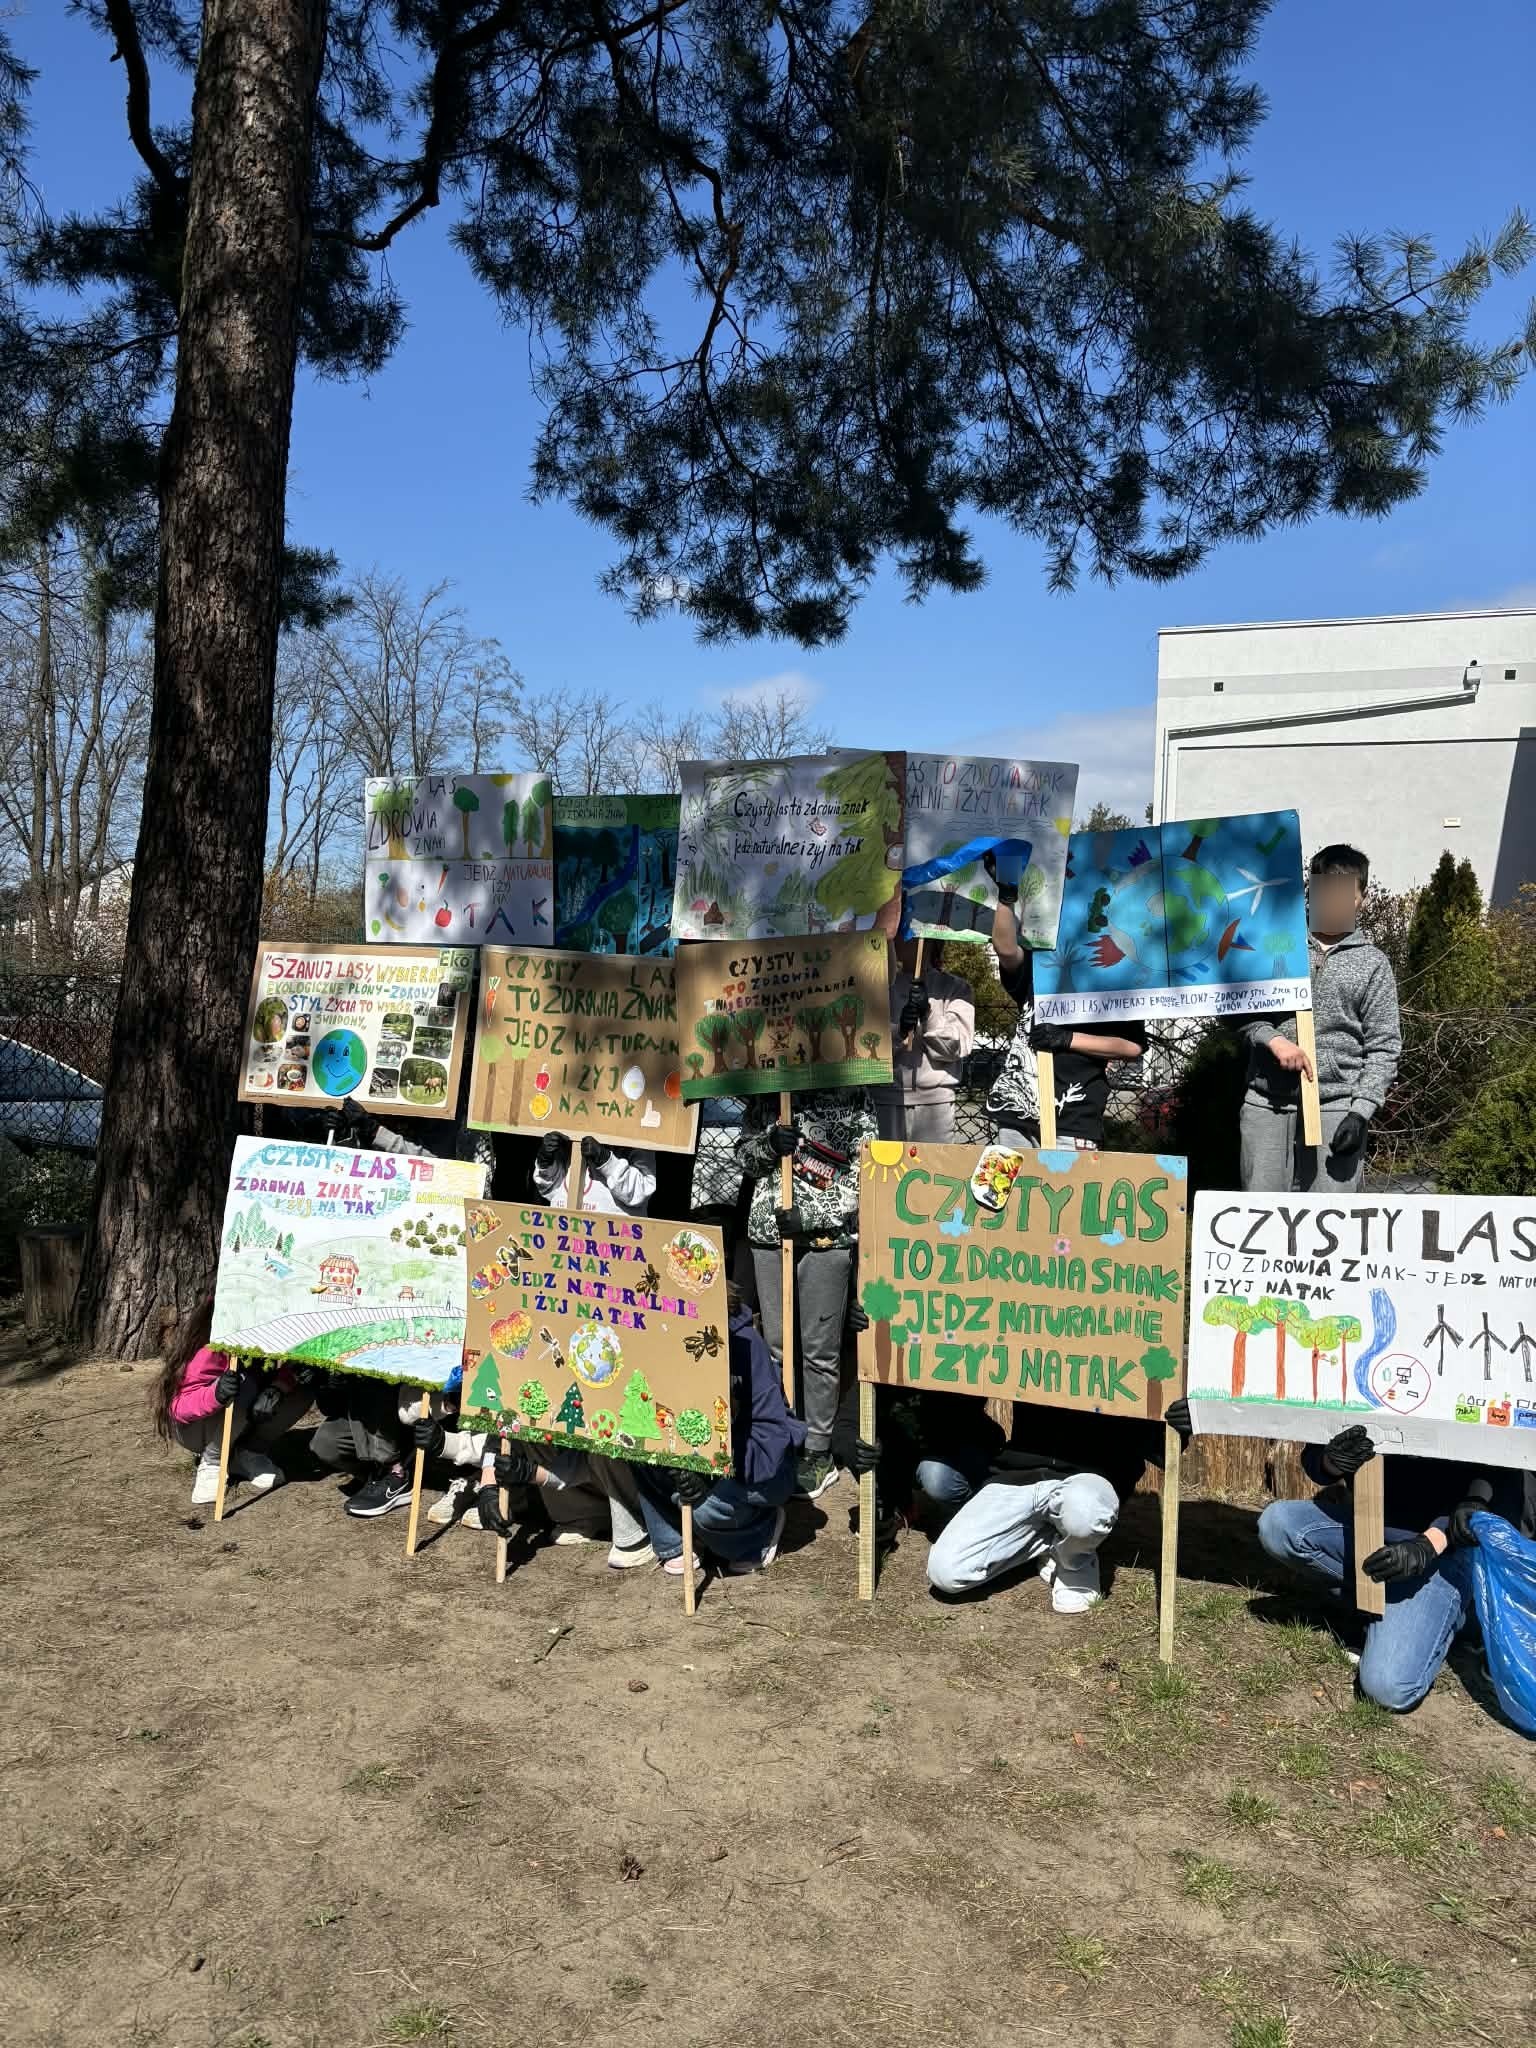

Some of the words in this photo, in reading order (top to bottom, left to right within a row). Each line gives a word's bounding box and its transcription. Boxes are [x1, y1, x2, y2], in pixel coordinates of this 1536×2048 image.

[366, 777, 424, 798] CZYSTY
[428, 777, 457, 797] LAS
[931, 760, 957, 784] TO
[1020, 770, 1065, 792] ZNAK
[734, 791, 773, 832] Czysty
[775, 796, 788, 817] las
[790, 796, 801, 816] to
[803, 799, 841, 817] zdrowia
[843, 799, 870, 817] znak
[1018, 791, 1046, 817] TAK
[368, 811, 438, 850] ZDROWIA
[828, 843, 842, 857] na
[844, 838, 864, 857] tak
[463, 863, 497, 882] JEDZ
[463, 897, 548, 936] TAK
[505, 955, 582, 982] CZYSTY
[728, 951, 795, 978] CZYSTY
[267, 981, 344, 996] EKOLOGICZNE
[348, 983, 383, 995] PLONY
[389, 986, 438, 999] ZDROWY
[289, 995, 323, 1012] STYL
[359, 1000, 374, 1013] TO
[507, 984, 541, 1013] TO
[621, 986, 679, 1023] ZNAK
[722, 980, 746, 998] TO
[1039, 1000, 1077, 1019] SZANUJ
[1293, 986, 1309, 999] TO
[503, 1017, 567, 1056] JEDZ
[562, 1063, 568, 1086] I
[558, 1092, 590, 1118] NA
[596, 1101, 636, 1118] TAK
[261, 1144, 336, 1168] CZYSTY
[349, 1154, 398, 1181] LAS
[407, 1159, 435, 1182] TO
[803, 1156, 835, 1180] MARVEL
[233, 1176, 306, 1197] ZDROWIA
[316, 1182, 365, 1201] ZNAK
[319, 1200, 336, 1213] NA
[343, 1200, 376, 1215] TAK
[1080, 1177, 1169, 1242] LAS
[519, 1209, 596, 1237] CZYSTY
[607, 1220, 643, 1240] LAS
[1210, 1206, 1403, 1258] CZYSTY
[1421, 1209, 1536, 1263] LAS
[520, 1232, 545, 1250] TO
[557, 1235, 647, 1264] ZDROWIA
[551, 1253, 611, 1278] ZNAK
[888, 1237, 933, 1281] TO
[936, 1242, 1087, 1291] ZDROWIA
[1204, 1250, 1232, 1271] TO
[1242, 1257, 1332, 1277] ZDROWIA
[1425, 1271, 1487, 1287] JEDZ
[567, 1277, 699, 1319] NATURALNIE
[1203, 1279, 1210, 1294] I
[1265, 1278, 1294, 1296] NA
[1295, 1282, 1335, 1301] TAK
[521, 1293, 529, 1309] I
[534, 1290, 568, 1315] ŻYJ
[576, 1301, 604, 1321] NA
[608, 1307, 647, 1331] TAK
[902, 1290, 994, 1335] JEDZ
[999, 1301, 1163, 1344] NATURALNIE
[908, 1343, 922, 1381] I
[1018, 1347, 1062, 1393] NA
[1065, 1354, 1141, 1402] TAK
